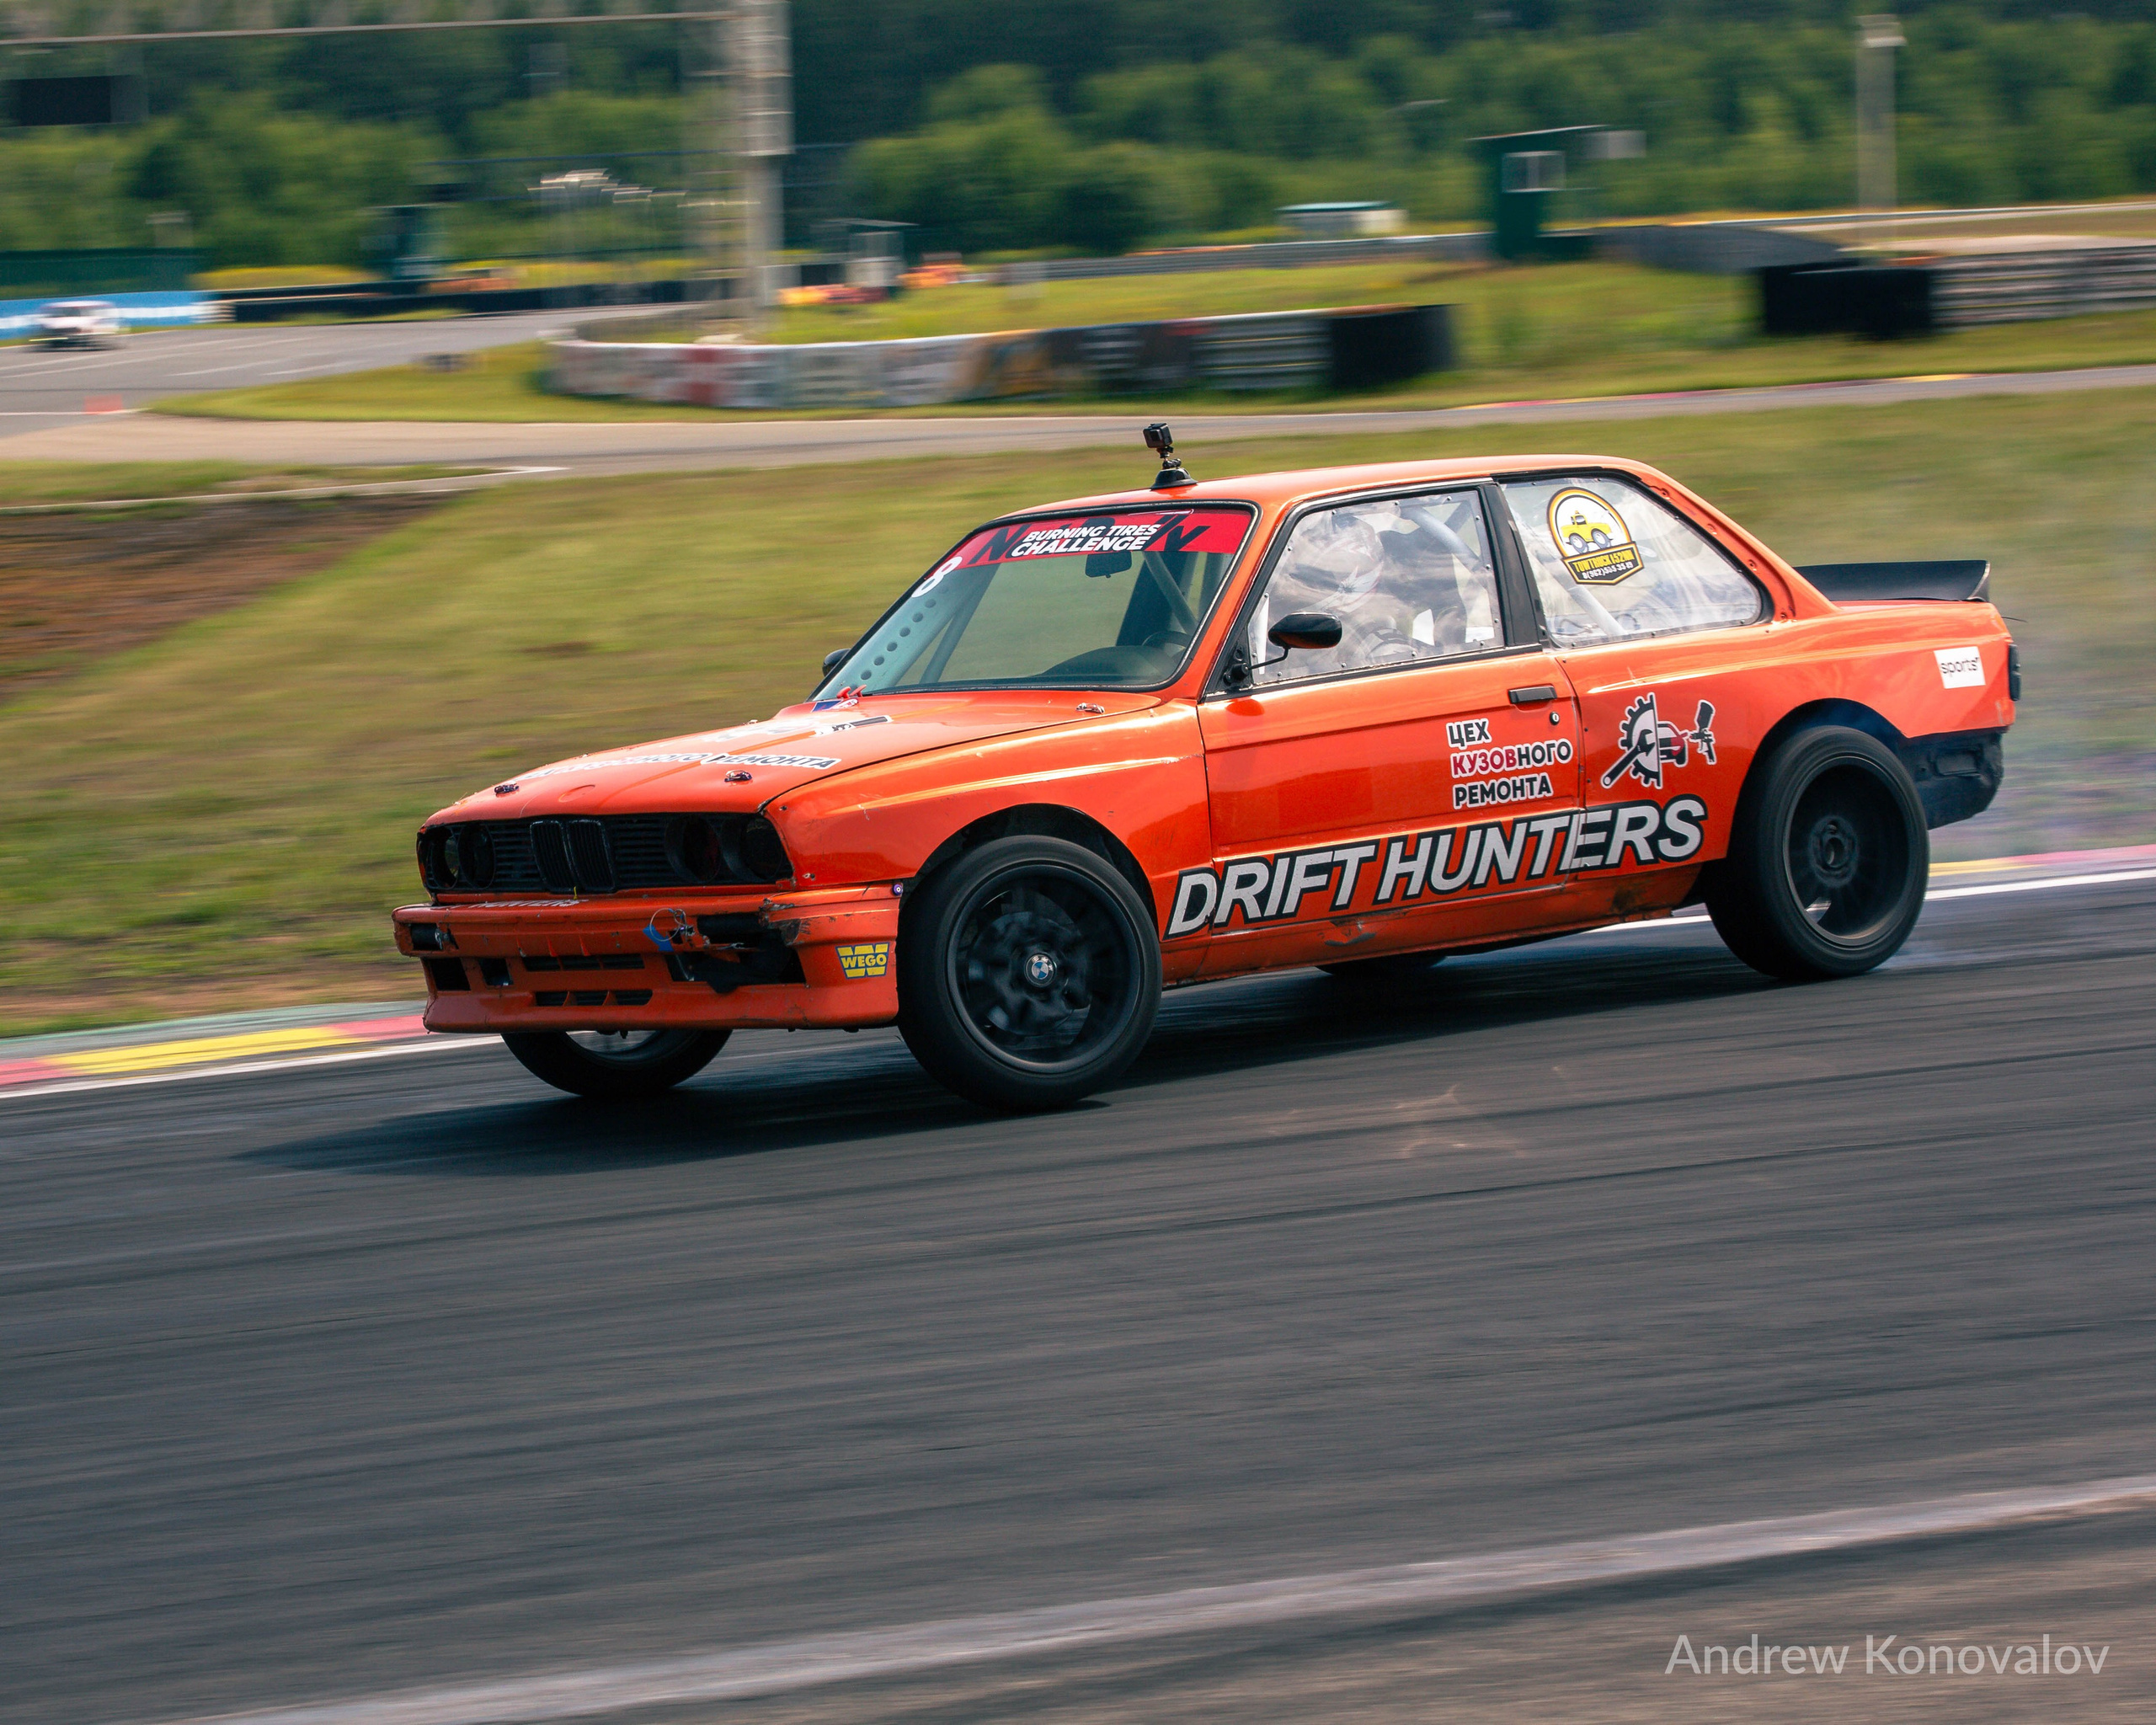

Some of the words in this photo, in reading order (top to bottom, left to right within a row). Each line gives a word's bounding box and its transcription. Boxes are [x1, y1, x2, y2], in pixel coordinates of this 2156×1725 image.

[1011, 537, 1151, 557] CHALLENGE
[1022, 526, 1104, 543] BURNING
[1106, 524, 1161, 537] TIRES
[911, 556, 963, 598] 8
[1448, 720, 1490, 747] ЦЕХ
[1452, 740, 1572, 775] КУЗОВНОГО
[1454, 774, 1552, 808] РЕМОНТА
[1166, 844, 1376, 936] DRIFT
[1376, 798, 1705, 901] HUNTERS
[841, 953, 887, 969] WEGO
